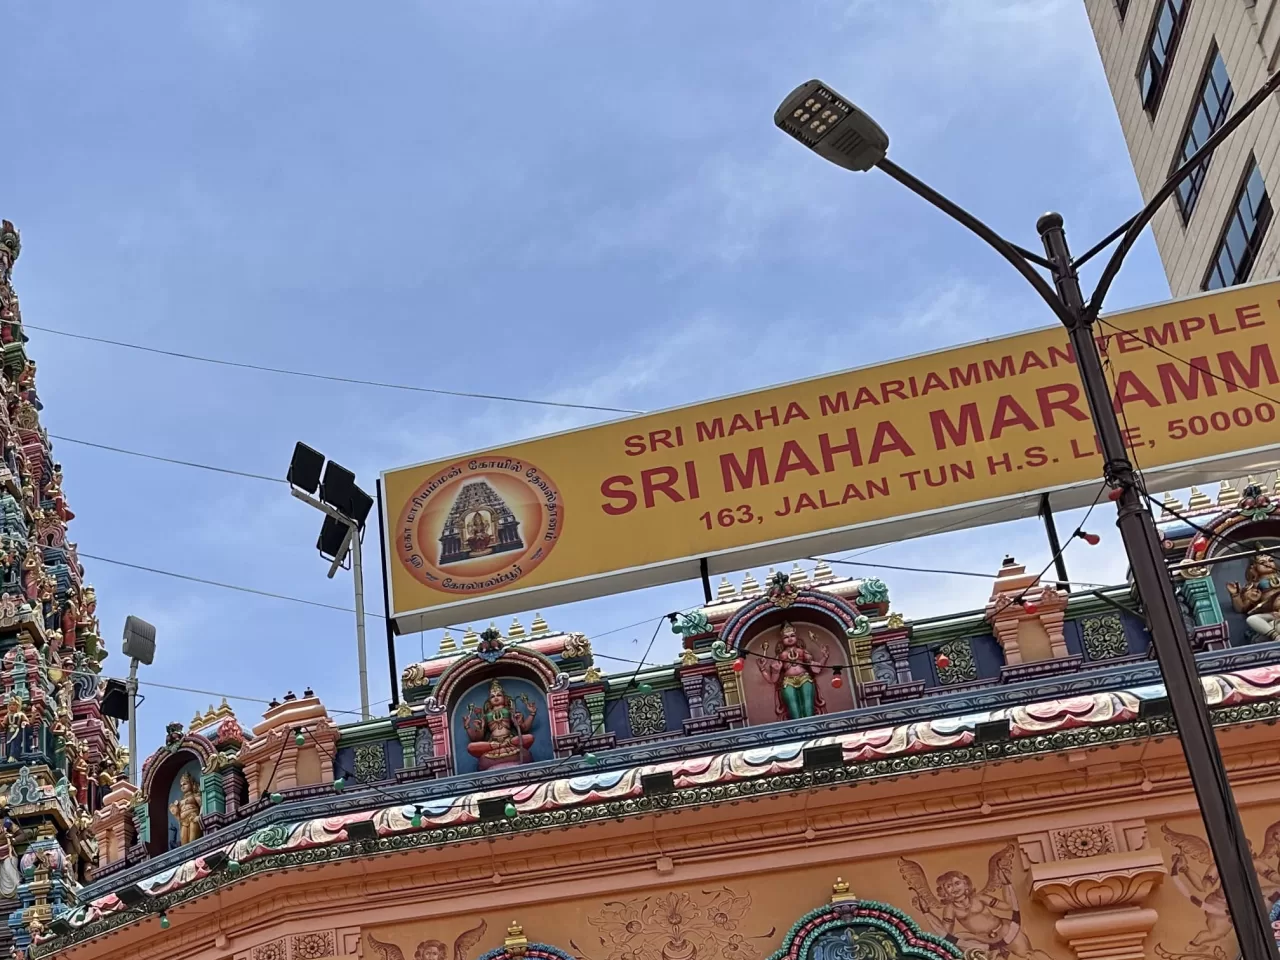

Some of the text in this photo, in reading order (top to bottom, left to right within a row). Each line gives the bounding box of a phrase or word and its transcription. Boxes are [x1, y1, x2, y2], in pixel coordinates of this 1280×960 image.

[600, 343, 1280, 515] SRI MAHA MARAMM
[624, 303, 1265, 457] SRI MAHA MARIAMMAN TEMPLE
[468, 459, 523, 473] கோயில்
[699, 504, 763, 530] 163,
[774, 477, 890, 517] JALAN
[899, 460, 975, 491] TUN
[986, 446, 1059, 475] H.S.
[1168, 402, 1276, 439] 50000
